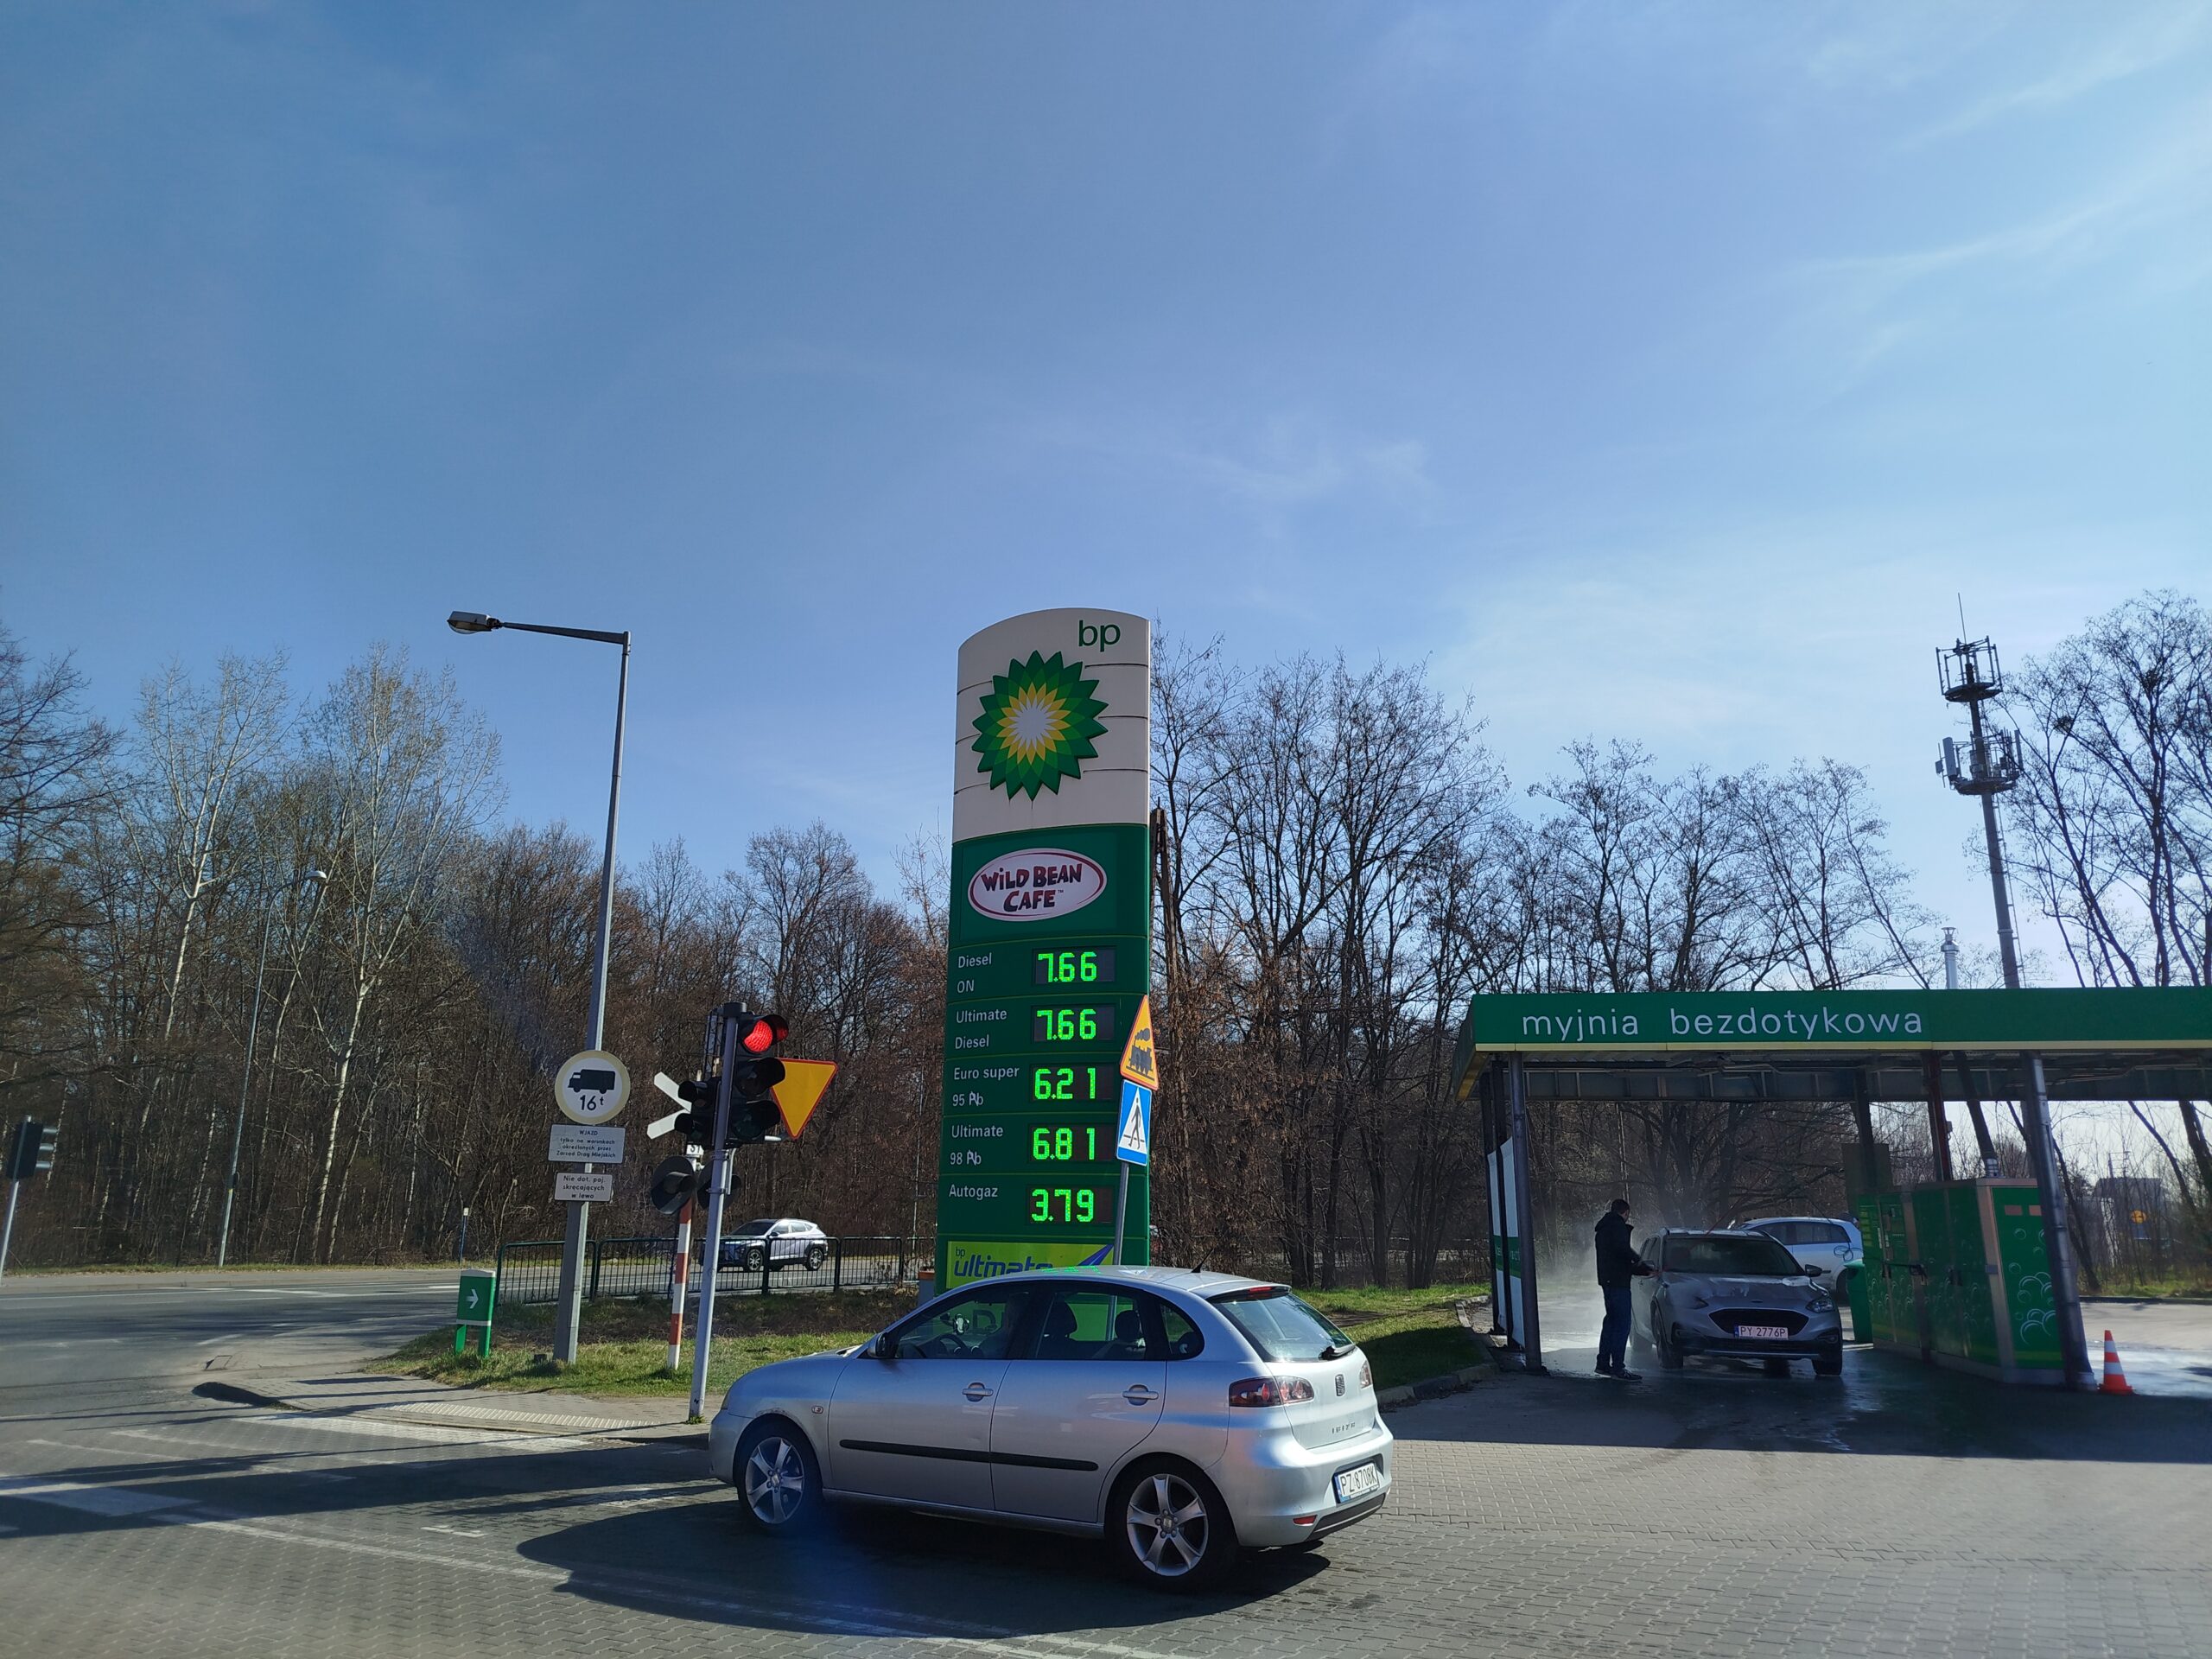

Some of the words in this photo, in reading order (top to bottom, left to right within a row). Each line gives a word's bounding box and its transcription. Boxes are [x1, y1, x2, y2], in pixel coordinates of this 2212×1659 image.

[1078, 620, 1121, 652] bp
[1033, 863, 1083, 888] BEAN
[1003, 889, 1056, 912] CAFE
[957, 952, 992, 969] Diesel
[1038, 951, 1097, 982] 7.66
[957, 980, 975, 994] ON
[956, 1008, 1007, 1024] Ultimate
[1036, 1008, 1096, 1040] 7.66
[1522, 1007, 1639, 1041] myjnia
[1669, 1006, 1923, 1040] bezdotykowa
[955, 1034, 989, 1050] Diesel
[953, 1067, 980, 1080] Euro
[982, 1066, 1020, 1082] super
[952, 1093, 965, 1107] 95
[951, 1124, 1004, 1138] Ultimate
[950, 1152, 963, 1166] 98
[949, 1184, 999, 1201] Autogaz
[1031, 1189, 1094, 1223] 3.79
[955, 1246, 966, 1259] bp
[1740, 1326, 1752, 1336] PY
[1757, 1327, 1786, 1338] 2776P
[1339, 1473, 1355, 1496] PZ
